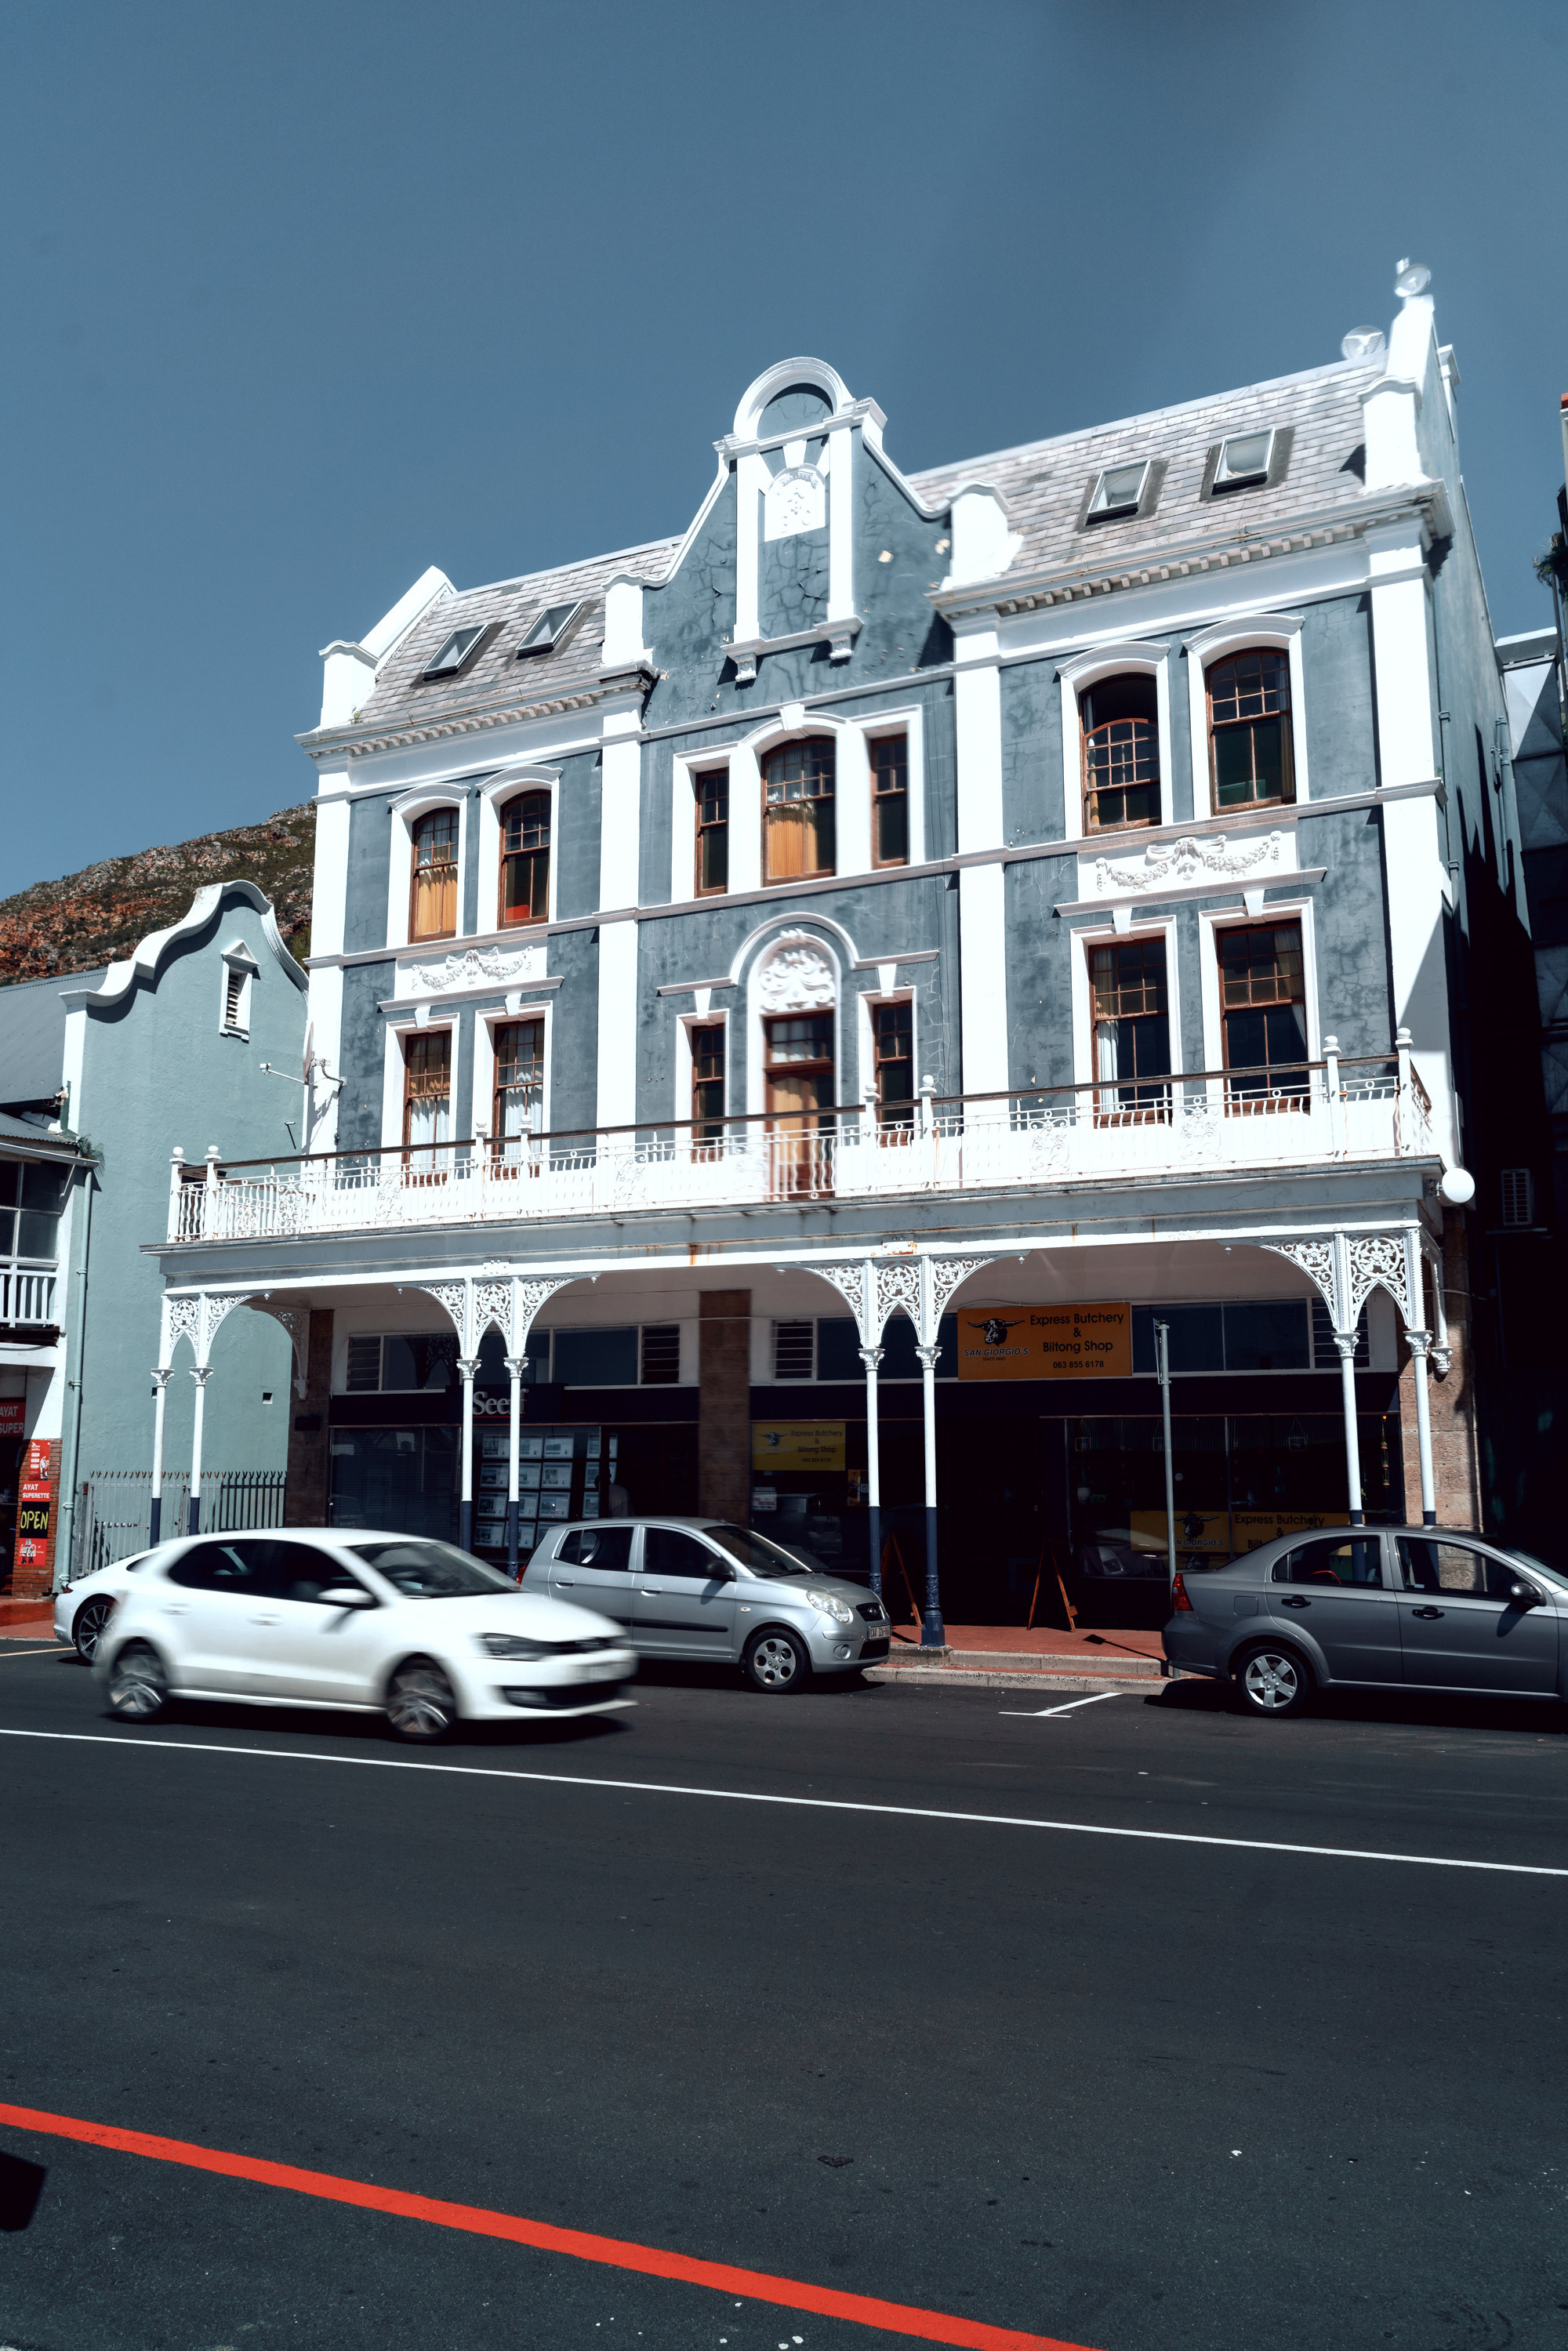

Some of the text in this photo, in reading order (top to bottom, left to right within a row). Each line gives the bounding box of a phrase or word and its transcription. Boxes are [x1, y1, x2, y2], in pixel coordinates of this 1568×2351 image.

[1030, 1312, 1124, 1327] Express Butchery
[1073, 1327, 1082, 1337] &
[984, 1348, 1029, 1356] GIORGIO'S
[1043, 1341, 1113, 1354] Biltong Shop
[473, 1388, 529, 1415] Seef
[0, 1406, 19, 1417] AYAT
[797, 1446, 819, 1454] Biltong
[20, 1510, 49, 1530] OPEN
[1235, 1514, 1273, 1526] Express
[1276, 1527, 1284, 1537] &
